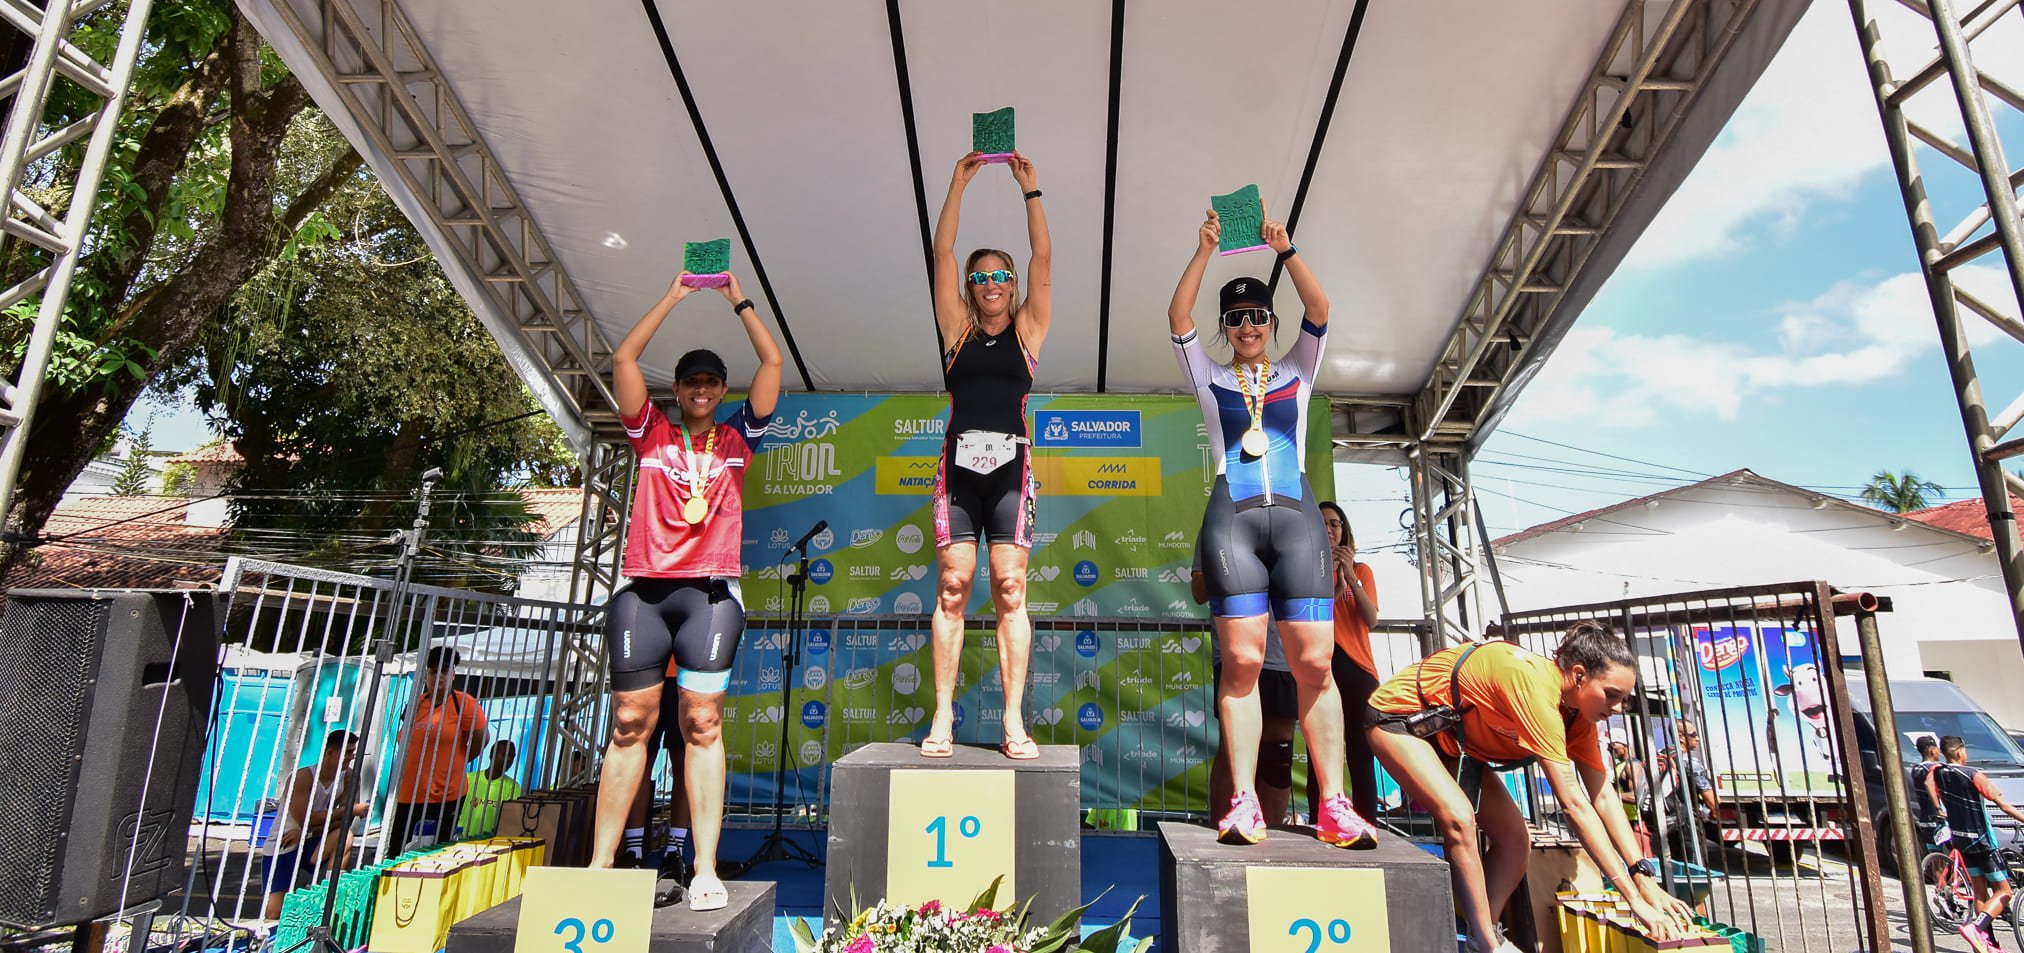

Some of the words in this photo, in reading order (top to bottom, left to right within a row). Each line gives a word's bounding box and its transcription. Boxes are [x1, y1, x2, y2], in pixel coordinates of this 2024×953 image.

[895, 419, 944, 433] SALTUR
[1071, 421, 1131, 432] SALVADOR
[972, 457, 997, 468] 229
[764, 484, 833, 495] SALVADOR
[1088, 480, 1137, 489] CORRIDA
[850, 566, 880, 576] SALTUR
[1115, 568, 1148, 578] SALTUR
[846, 635, 877, 646] SALTUR
[1118, 638, 1151, 648] SALTUR
[843, 708, 876, 719] SALTUR
[1121, 711, 1155, 721] SALTUR
